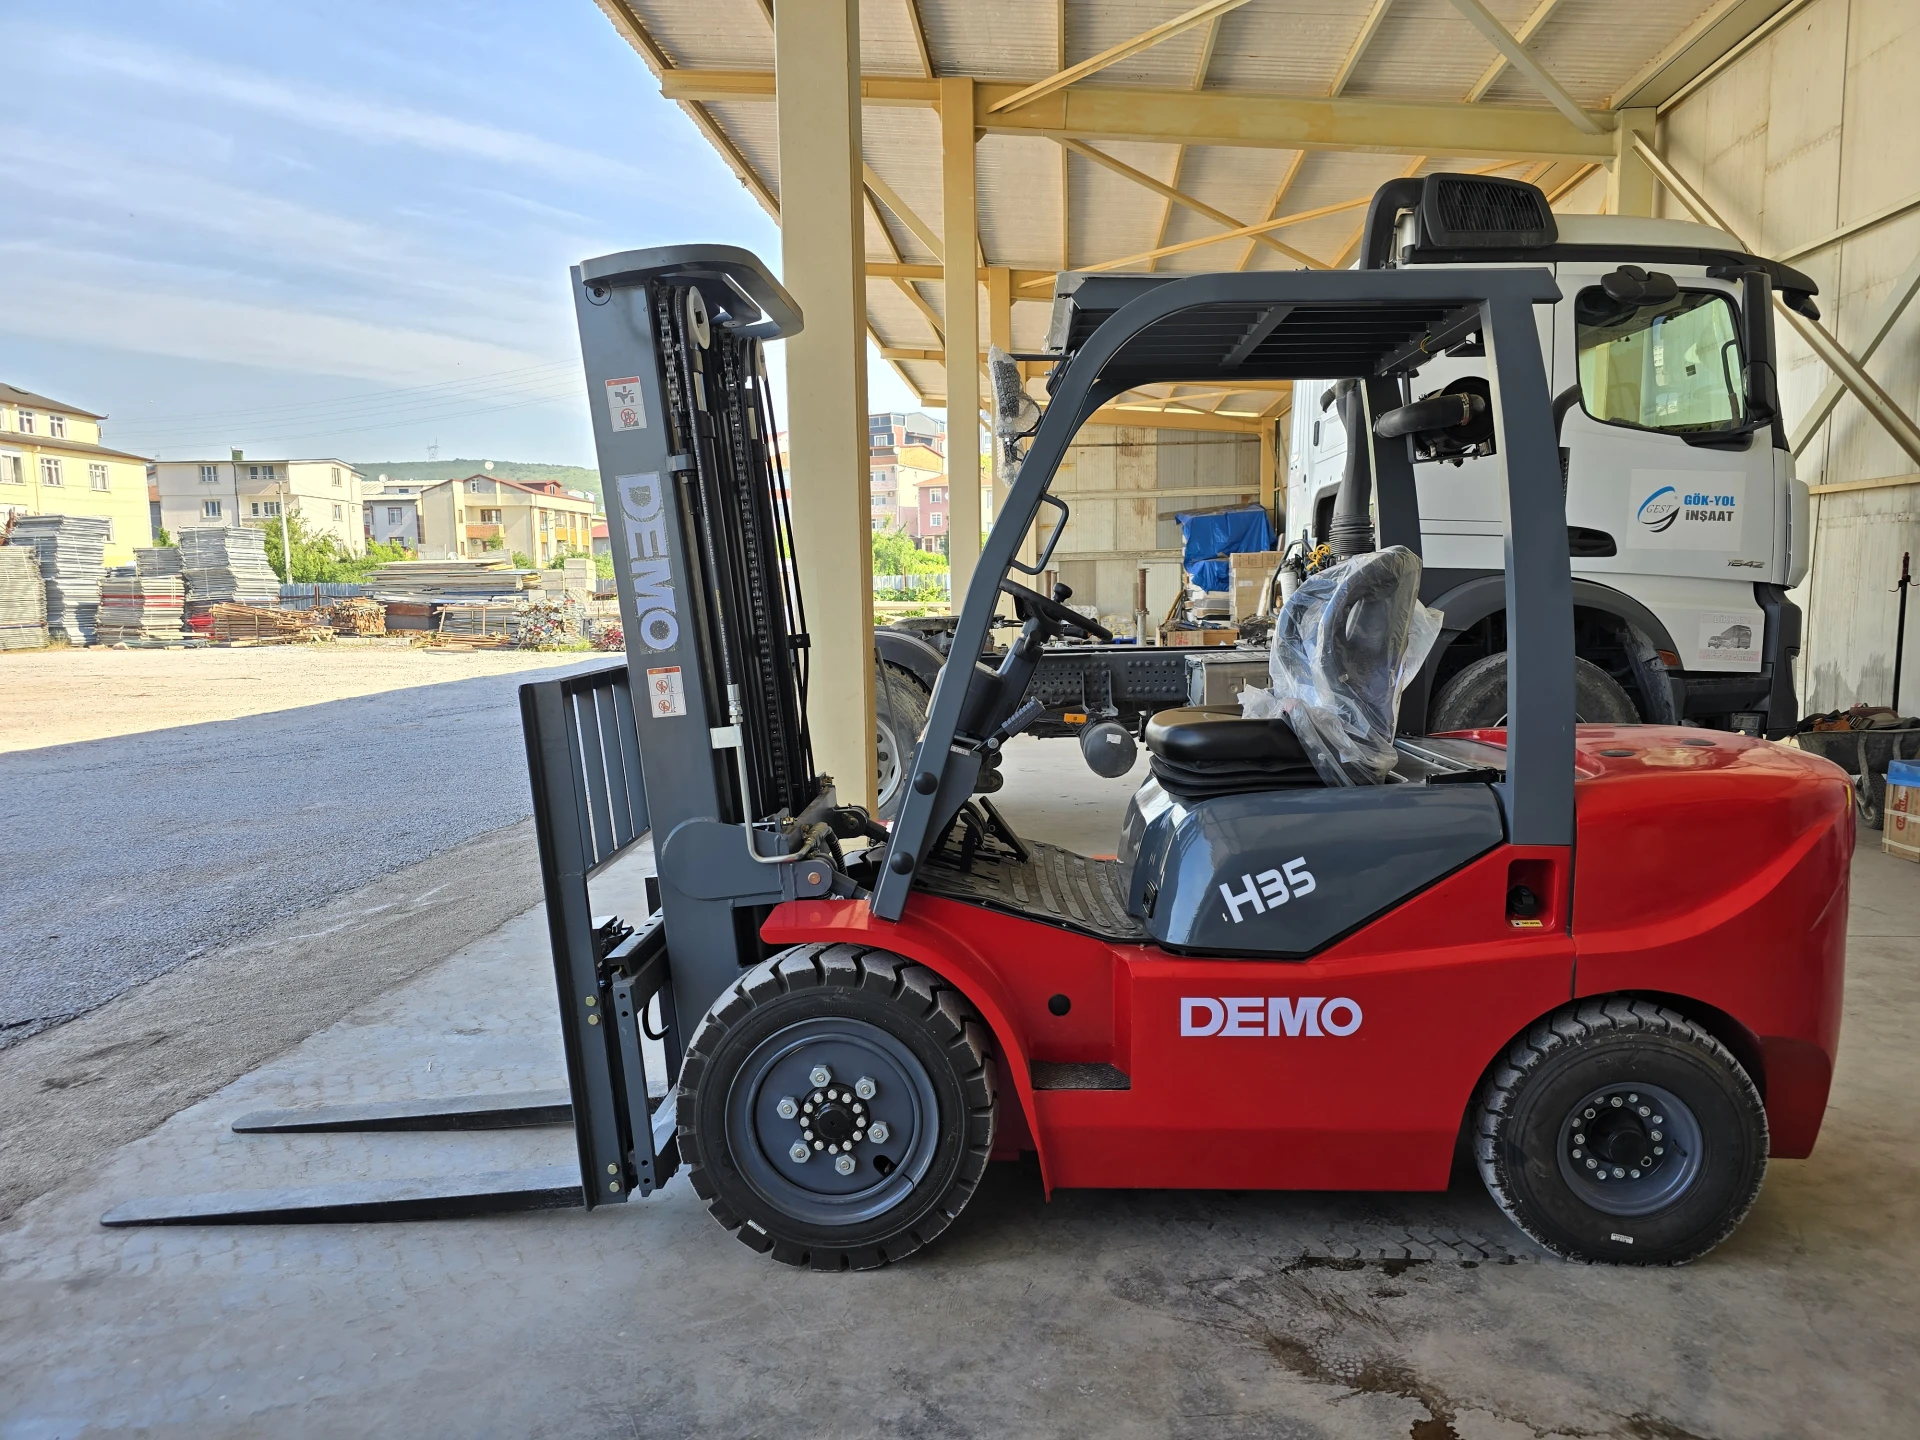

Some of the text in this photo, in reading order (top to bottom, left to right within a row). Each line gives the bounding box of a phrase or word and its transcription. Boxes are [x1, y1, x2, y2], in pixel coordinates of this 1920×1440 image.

[1646, 504, 1674, 514] GEST
[1684, 493, 1735, 506] GÖK-YOL
[1685, 510, 1734, 522] İNŞAAT
[618, 475, 679, 650] DEMO
[1218, 856, 1317, 923] H35
[1180, 996, 1363, 1037] DEMO
